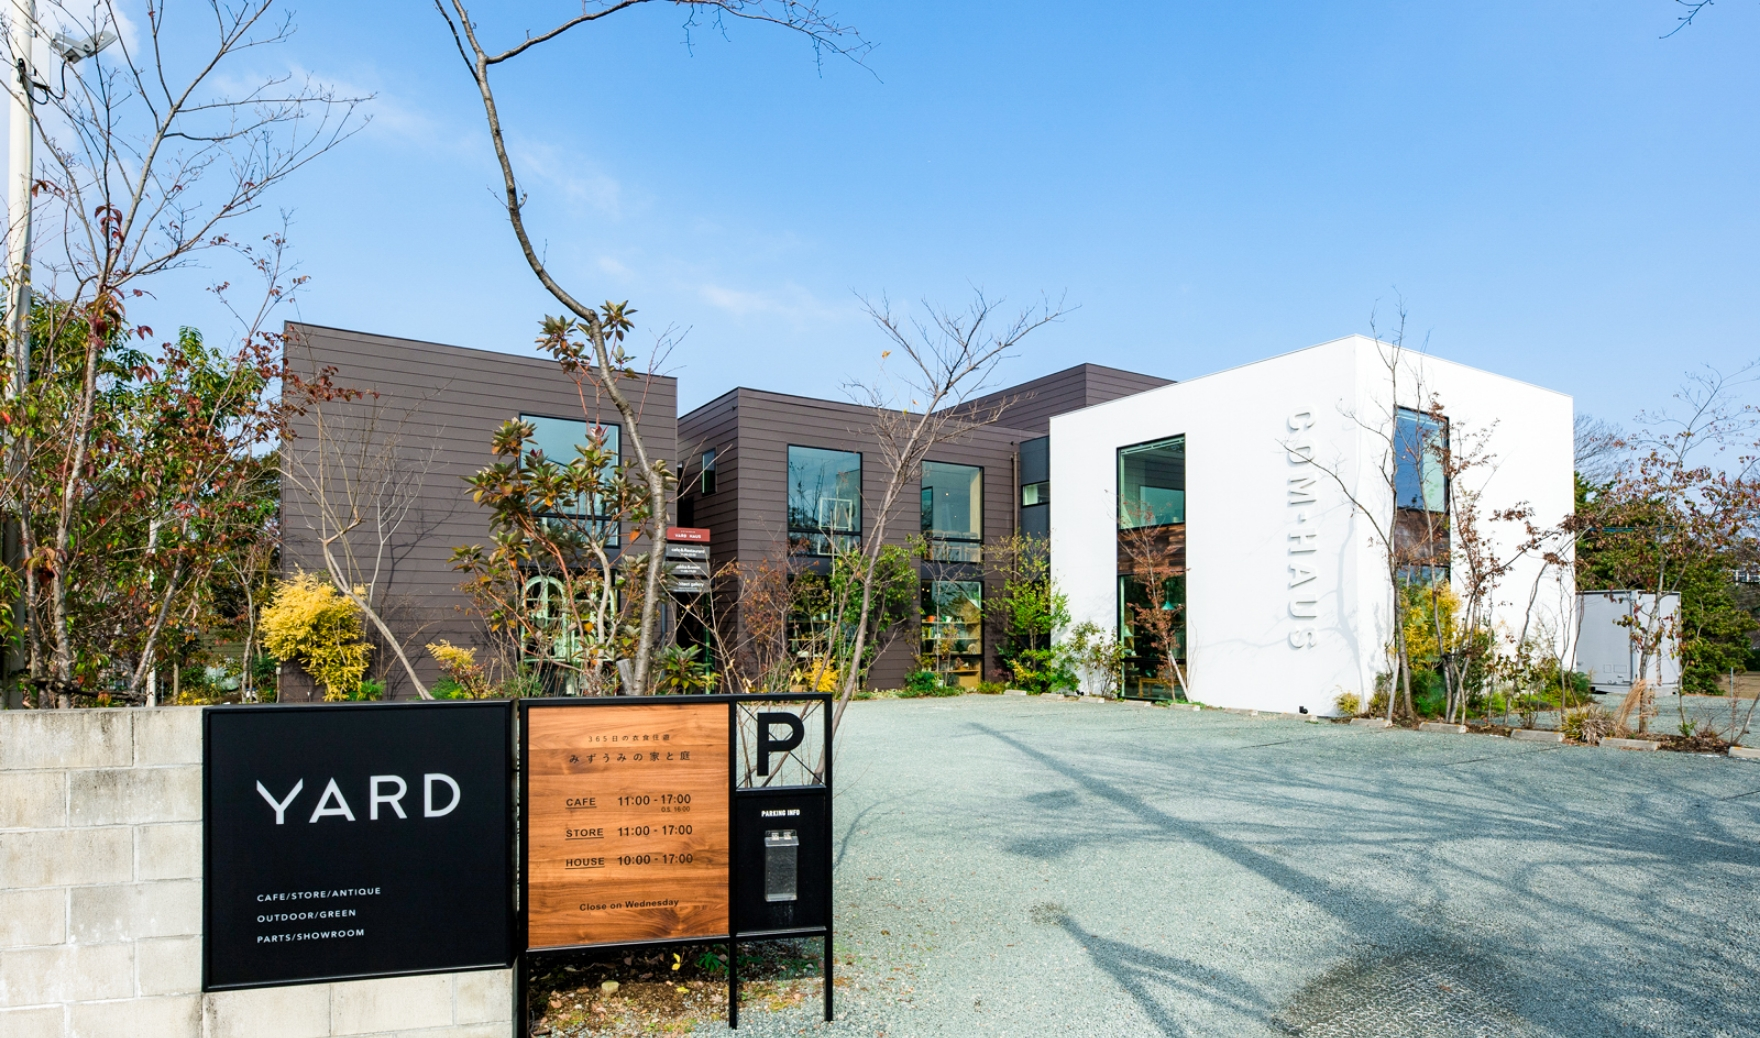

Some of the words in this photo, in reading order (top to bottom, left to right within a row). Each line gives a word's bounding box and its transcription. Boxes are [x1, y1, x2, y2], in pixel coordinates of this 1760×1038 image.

[757, 712, 805, 776] P
[569, 751, 690, 764] みずうみの家と庭
[256, 773, 461, 825] YARD
[565, 797, 596, 807] CAFE
[618, 795, 650, 806] 11:00
[661, 794, 691, 804] 17:00
[565, 828, 604, 838] STORE
[618, 826, 650, 836] 11:00
[662, 825, 693, 835] 17:00
[565, 857, 605, 867] HOUSE
[618, 855, 651, 866] 10:00
[662, 854, 693, 864] 17:00
[256, 887, 381, 902] CAFE/STORE/ANTIQUE
[580, 903, 607, 911] Close
[625, 899, 680, 908] Wednesday
[257, 909, 356, 923] OUTDOOR/GREEN
[257, 928, 365, 943] PARTS/SHOWROOM
